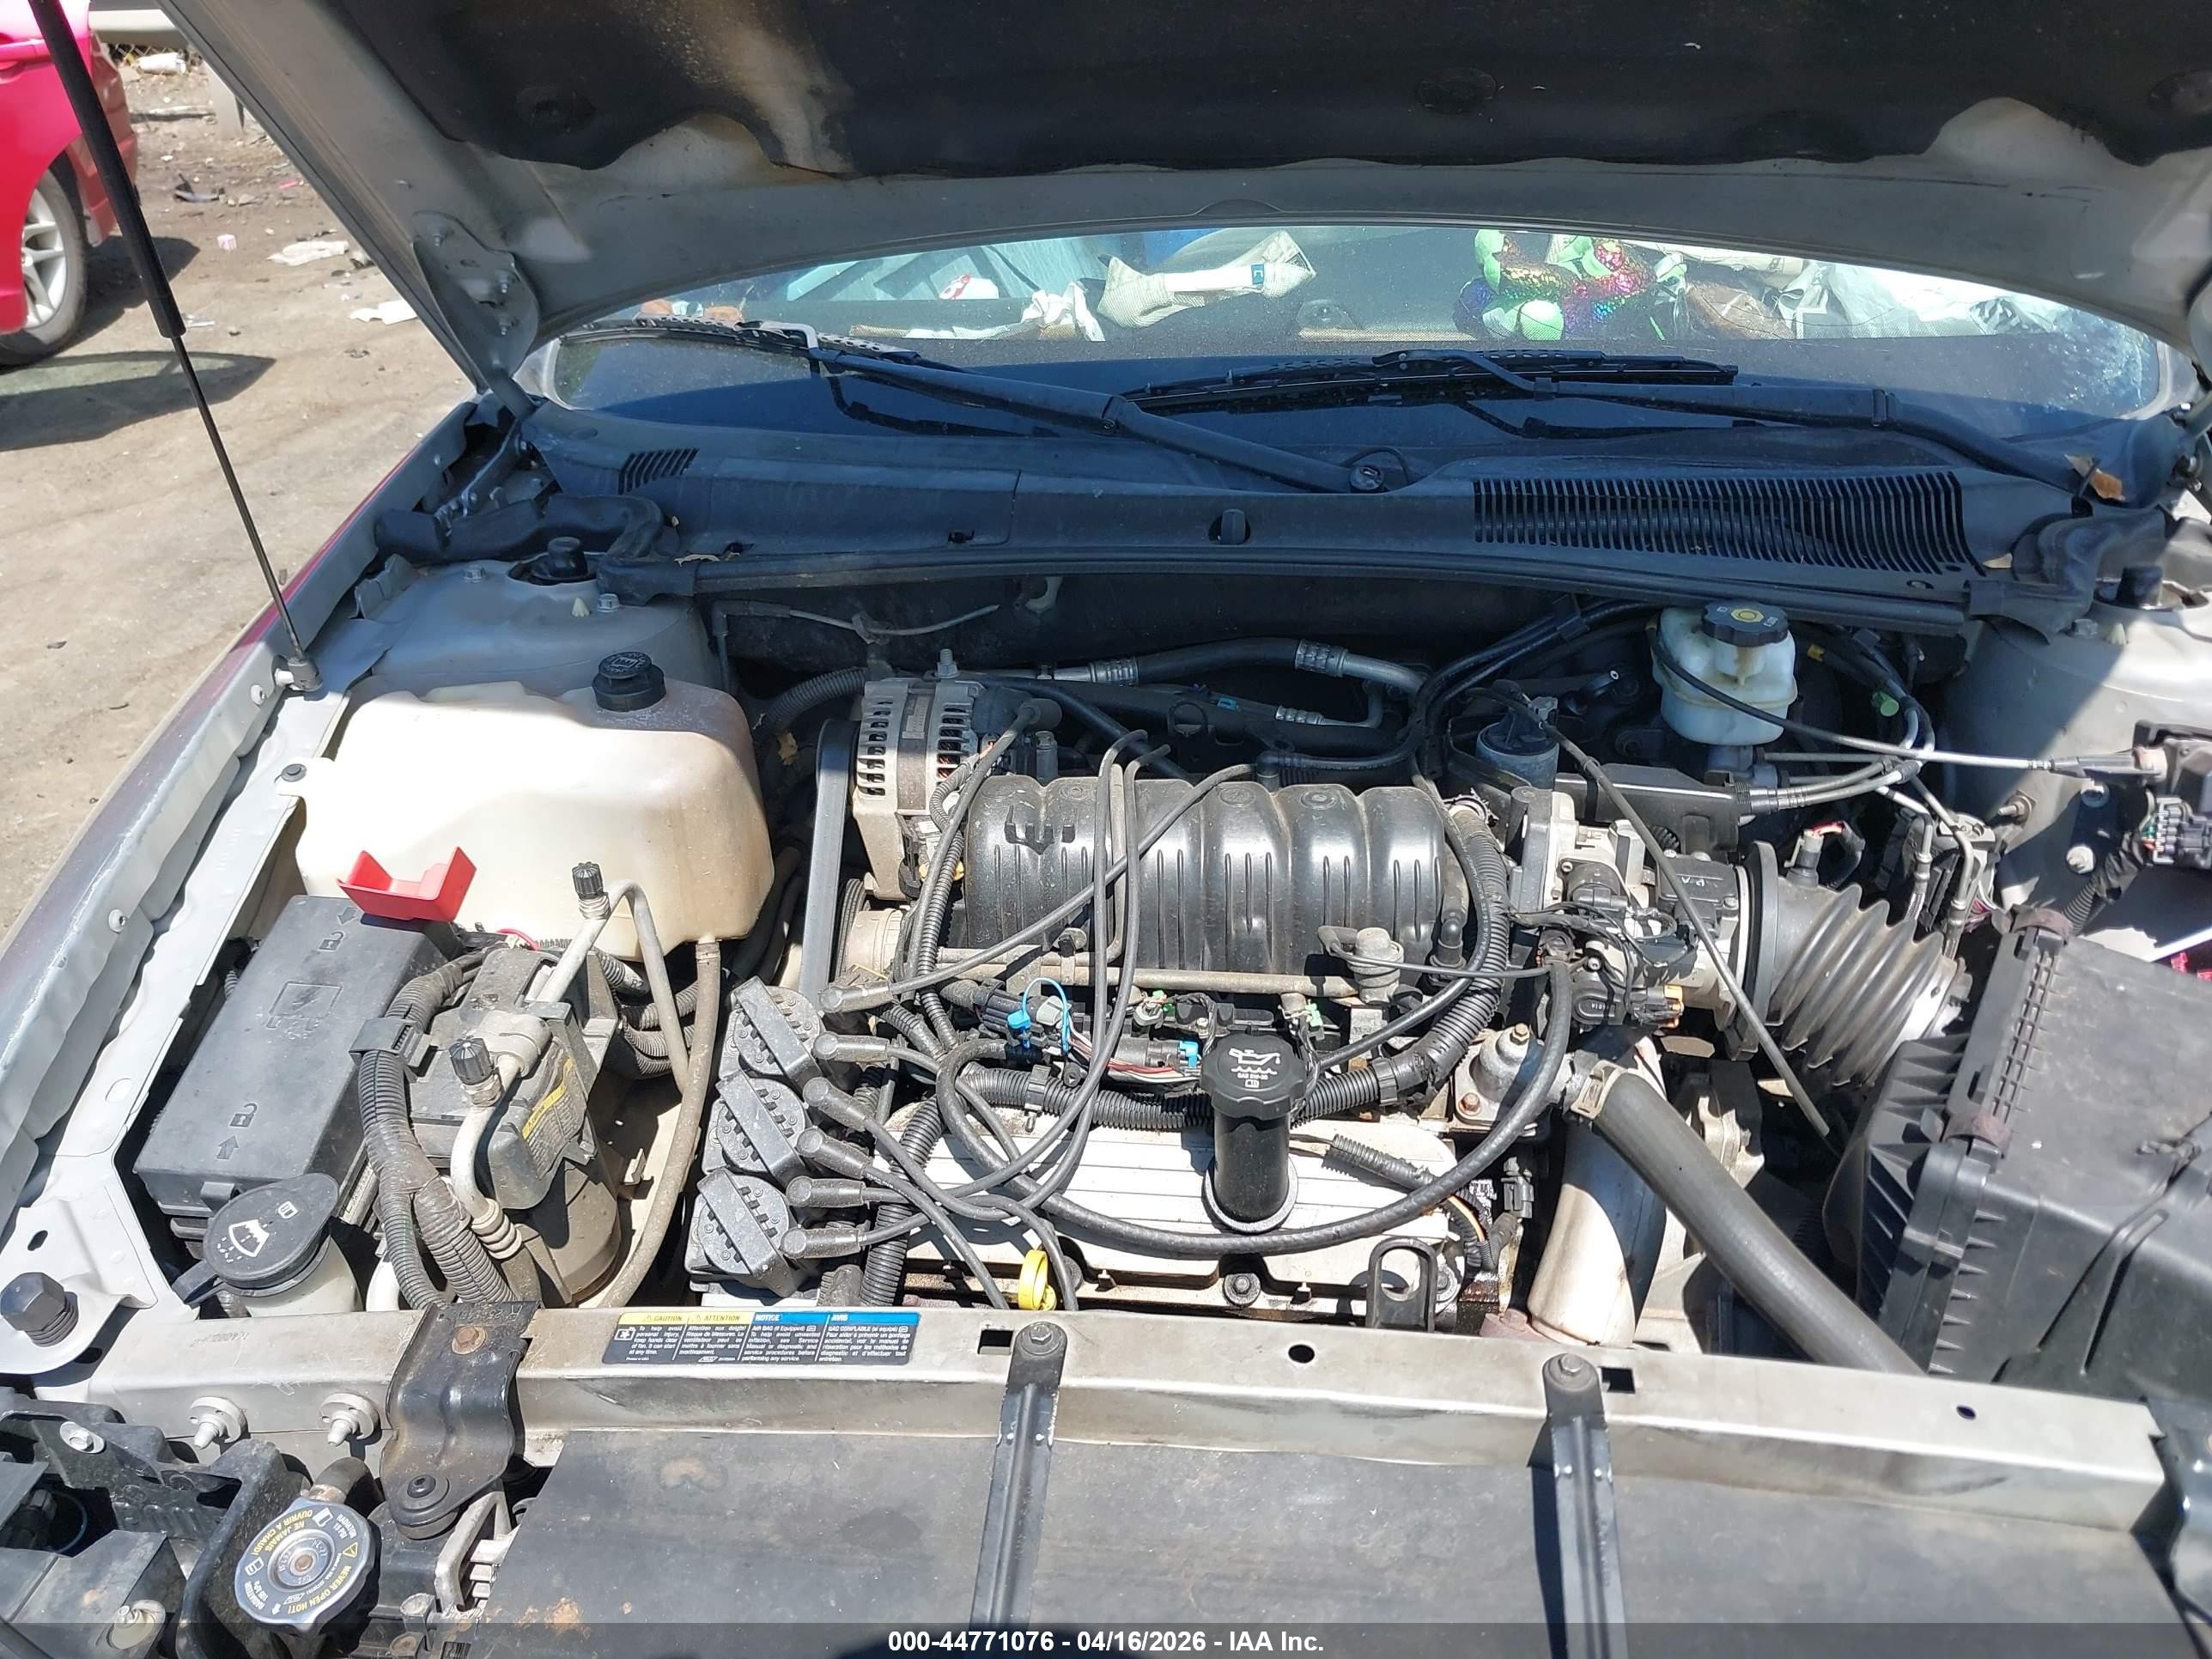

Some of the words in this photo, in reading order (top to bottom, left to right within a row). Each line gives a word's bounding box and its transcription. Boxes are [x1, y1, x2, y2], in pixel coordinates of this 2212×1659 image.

[283, 1510, 313, 1526] OUVRIR
[294, 1520, 305, 1530] NE
[336, 1514, 357, 1539] RADIATOR
[264, 1526, 292, 1552] JAMAIS
[329, 1565, 351, 1590] NEVER
[309, 1589, 331, 1607] OPEN
